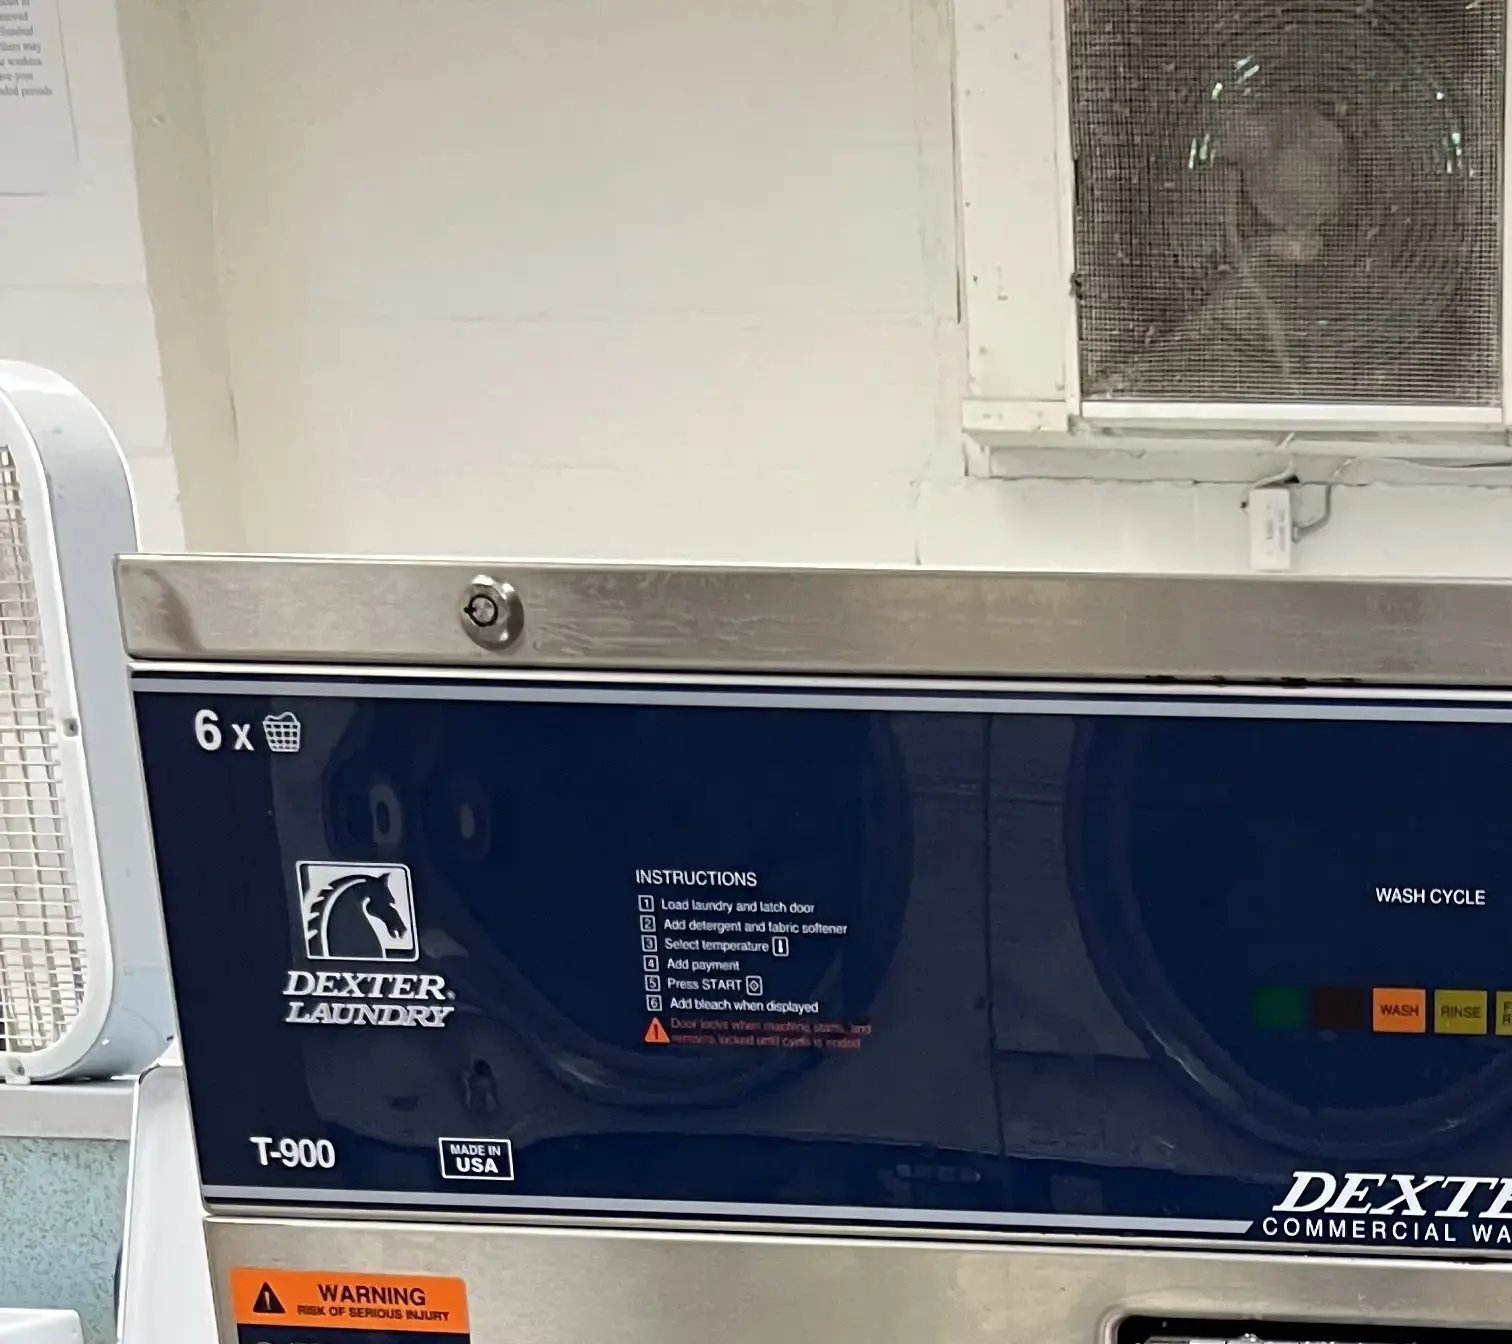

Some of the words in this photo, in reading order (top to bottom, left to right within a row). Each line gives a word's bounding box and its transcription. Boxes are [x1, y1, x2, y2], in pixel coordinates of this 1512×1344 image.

[194, 709, 222, 751] 6
[231, 723, 254, 751] x
[636, 870, 757, 887] INSTRUCTIONS
[1376, 888, 1426, 904] WASH
[1430, 889, 1486, 905] CYCLE
[661, 899, 689, 910] Load
[692, 900, 733, 914] laundry
[736, 901, 758, 912] and
[760, 901, 787, 913] latch
[790, 902, 814, 914] door
[664, 919, 686, 930] Add
[689, 920, 742, 934] detergent
[745, 921, 765, 932] and
[769, 922, 799, 934] fabric
[802, 922, 848, 934] softener
[664, 938, 698, 950] Select
[702, 940, 769, 953] temperature
[668, 958, 689, 970] Add
[692, 960, 740, 973] payment
[283, 971, 447, 1000] DEXTER
[668, 978, 698, 990] Press
[702, 979, 742, 991] START
[285, 1002, 454, 1028] LAUNDRY
[670, 998, 692, 1010] Add
[695, 999, 731, 1010] bleach
[733, 1000, 764, 1012] when
[766, 1001, 818, 1016] displayed
[1380, 1004, 1420, 1017] WASH
[1440, 1006, 1481, 1019] RINSE
[250, 1136, 336, 1169] T-900
[450, 1144, 485, 1156] MADE
[488, 1145, 501, 1158] IN
[456, 1156, 498, 1174] USA
[1262, 1217, 1456, 1242] COMMERCIAL
[318, 1284, 426, 1306] WARNING
[298, 1305, 327, 1316] RISK
[330, 1306, 346, 1317] OF
[349, 1308, 402, 1320] SERIOUS
[406, 1310, 450, 1321] INJURY
